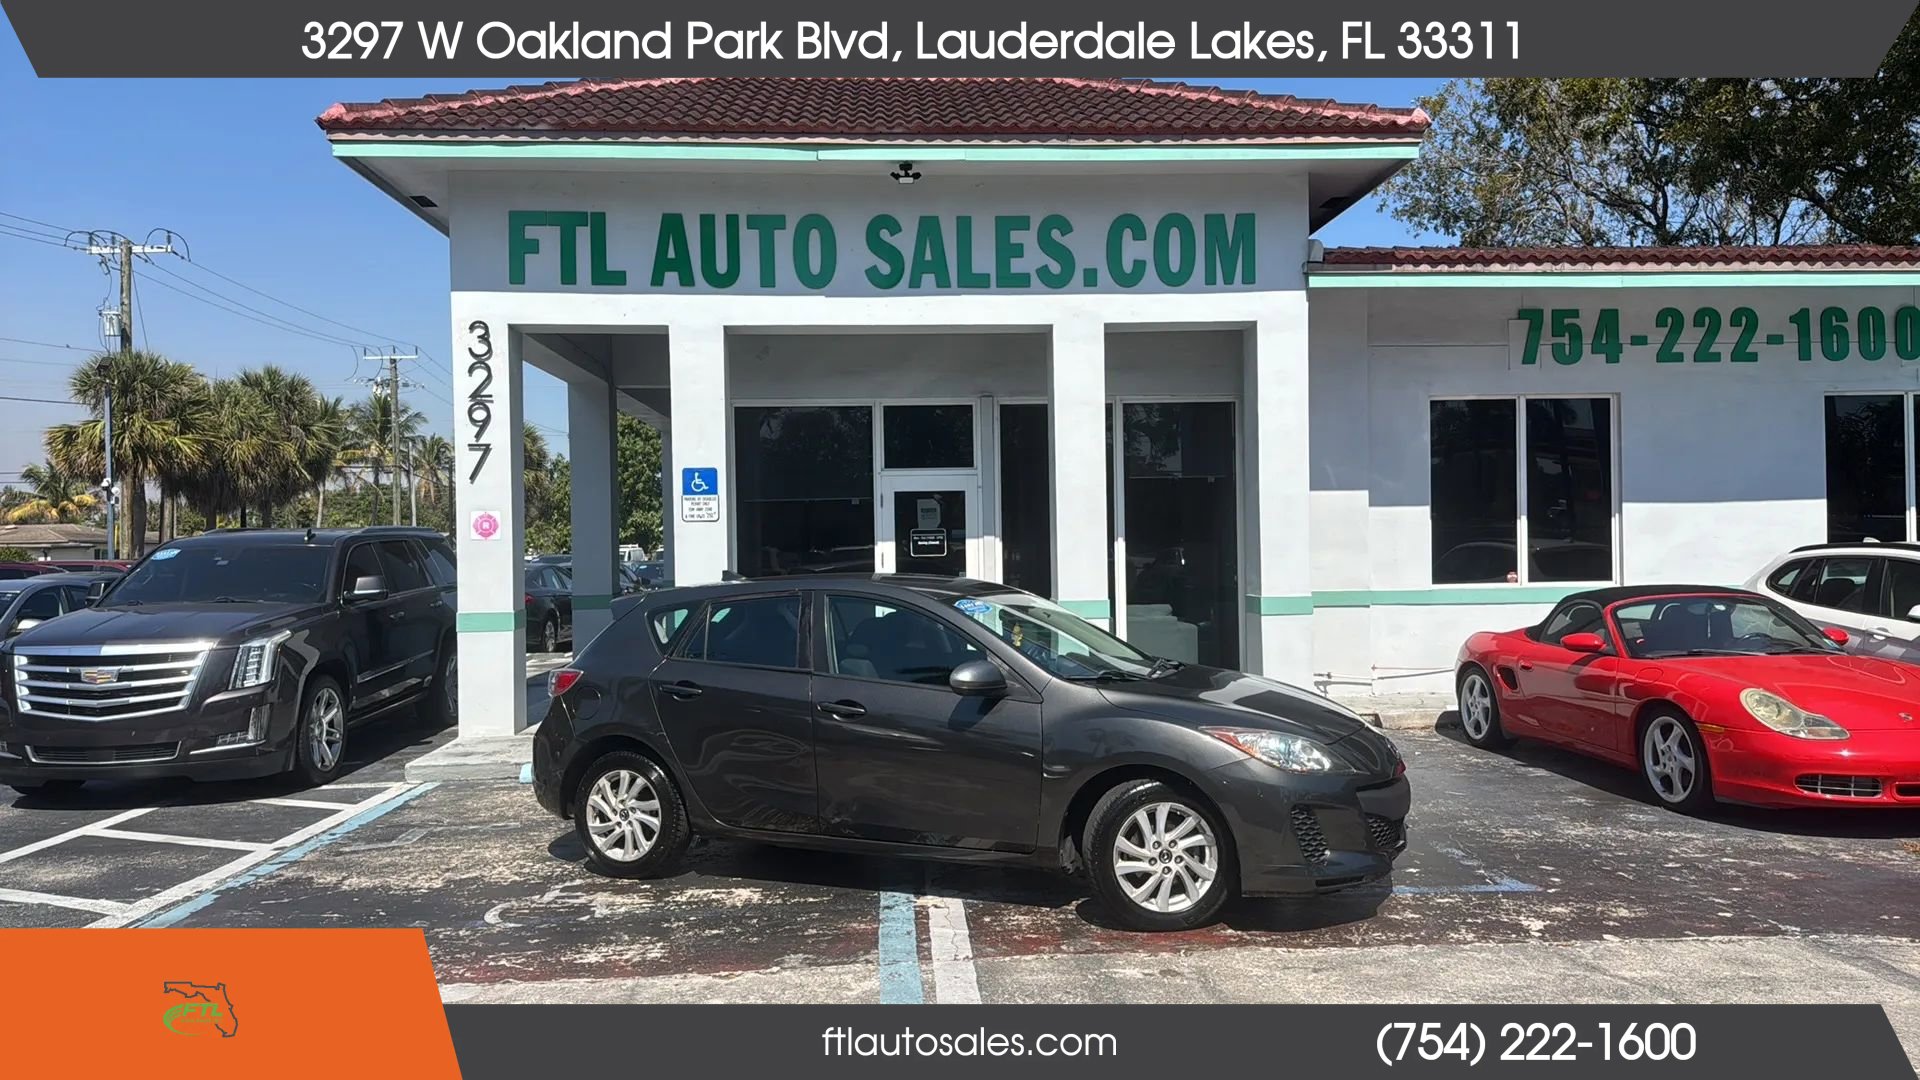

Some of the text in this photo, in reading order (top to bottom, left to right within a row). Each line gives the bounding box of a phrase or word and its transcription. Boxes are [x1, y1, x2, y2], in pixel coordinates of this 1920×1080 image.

[508, 210, 1258, 290] FTL AUTO SALES.COM
[1518, 305, 1920, 365] 754-222-1600
[467, 320, 493, 484] 3297
